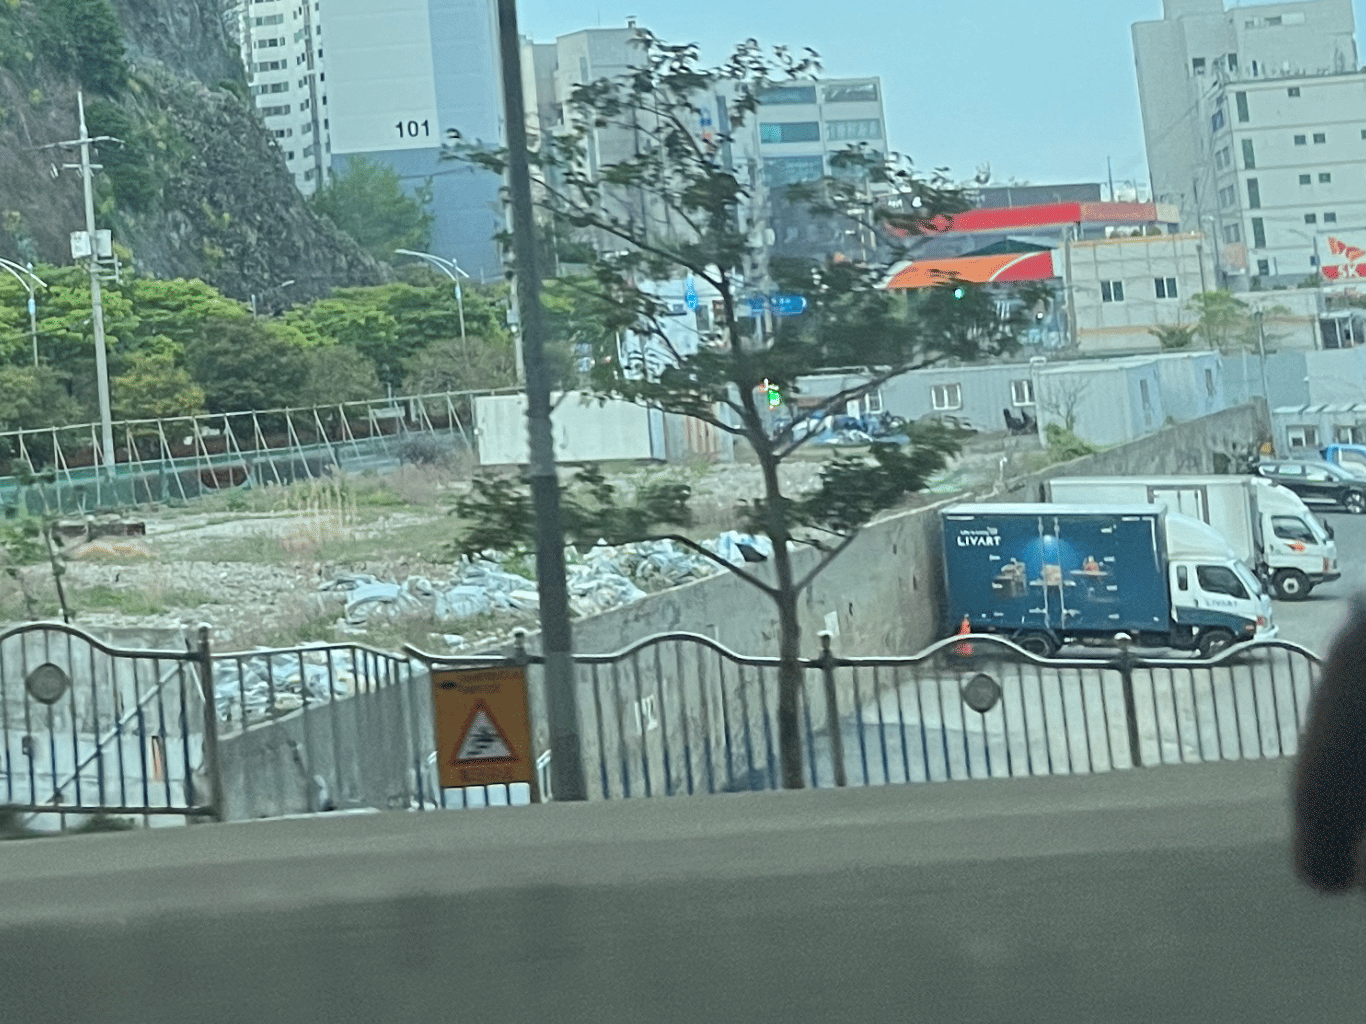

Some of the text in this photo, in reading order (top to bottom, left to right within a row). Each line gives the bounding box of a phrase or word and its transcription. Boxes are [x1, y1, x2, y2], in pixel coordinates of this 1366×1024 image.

[395, 119, 430, 138] 101
[1337, 257, 1357, 271] SK
[957, 536, 1001, 546] LIVART
